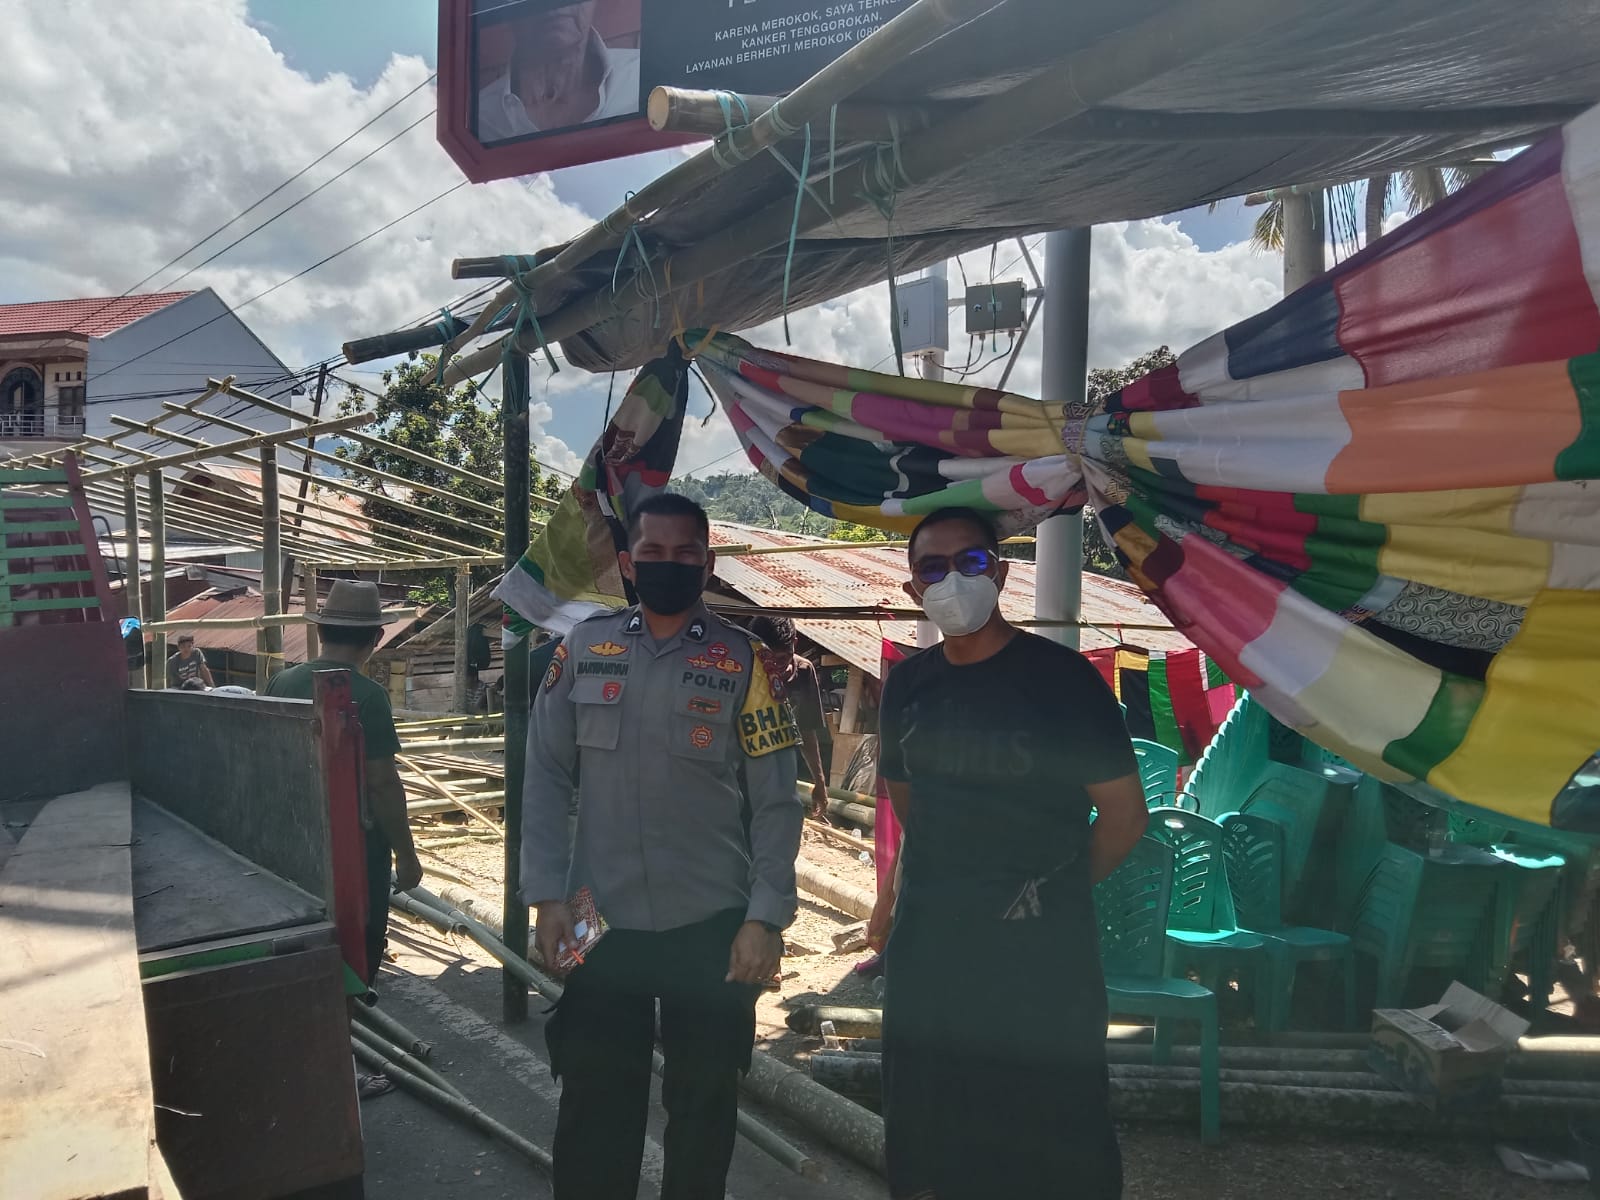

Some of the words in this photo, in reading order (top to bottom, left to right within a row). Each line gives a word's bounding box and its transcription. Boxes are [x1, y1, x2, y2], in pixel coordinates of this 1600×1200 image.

[714, 24, 758, 42] KARENA
[761, 10, 822, 31] MEROKOK,
[825, 3, 855, 18] SAYA
[741, 31, 787, 49] KANKER
[790, 12, 883, 39] TENGGOROKAN.
[686, 56, 733, 74] LAYANAN
[736, 44, 791, 64] BERHENTI
[794, 31, 853, 51] MEROKOK
[682, 671, 736, 693] POLRI
